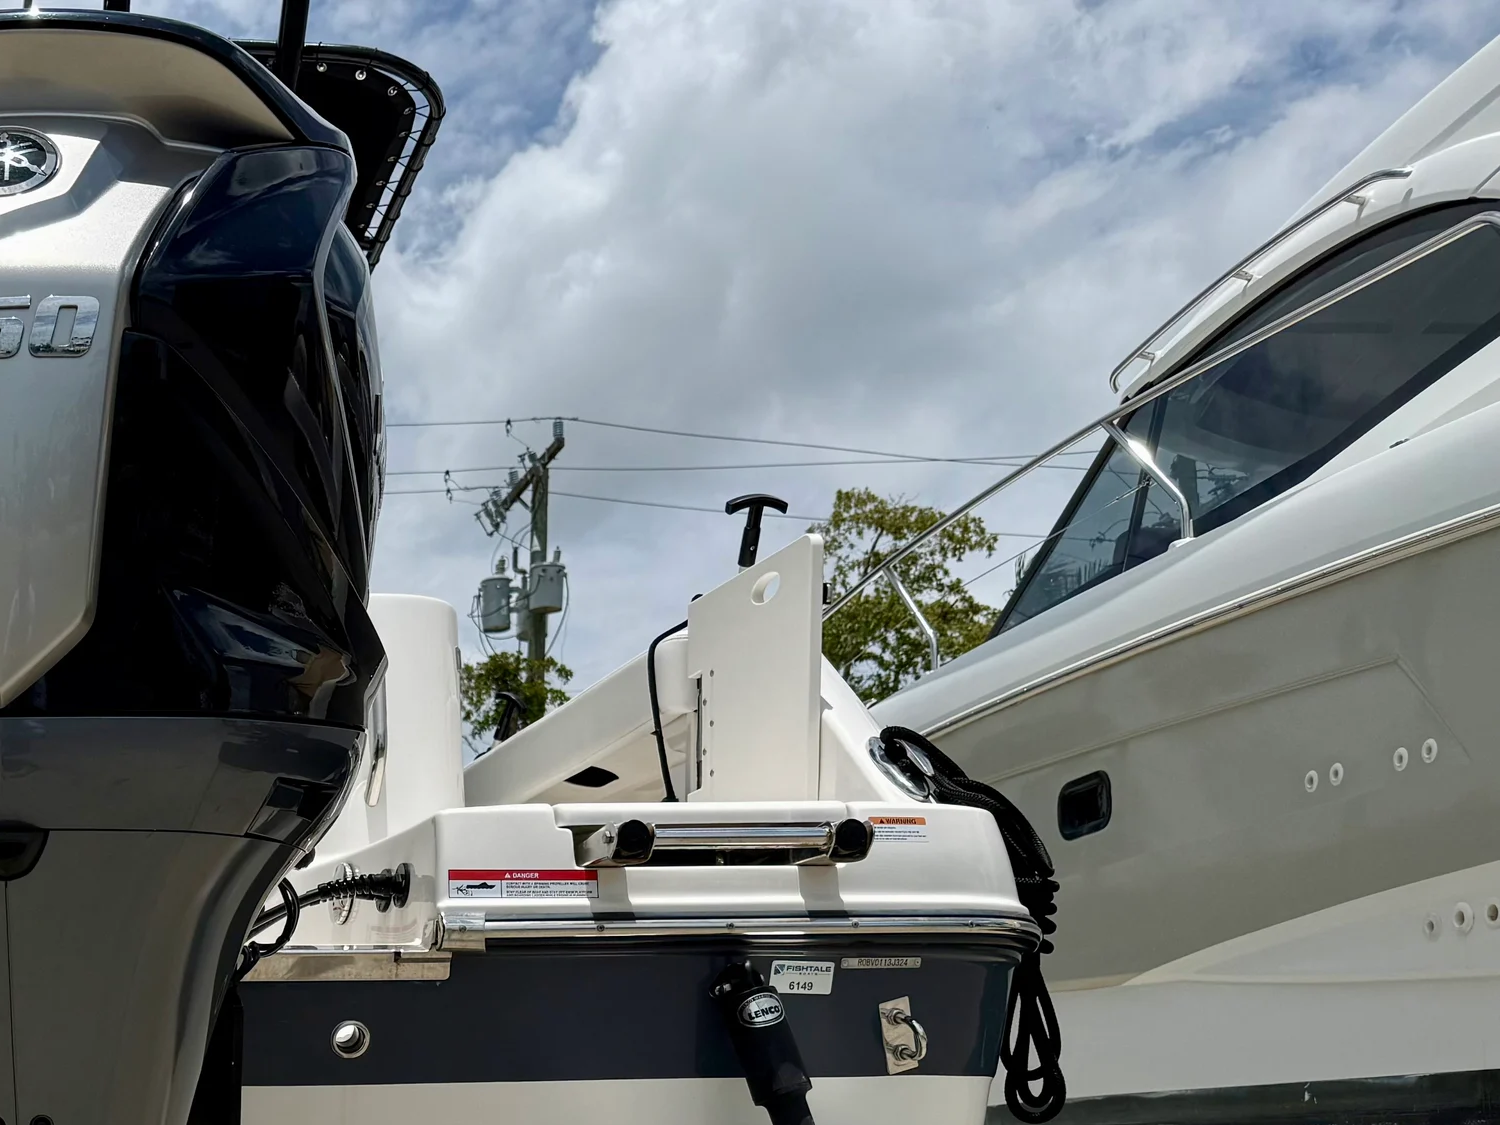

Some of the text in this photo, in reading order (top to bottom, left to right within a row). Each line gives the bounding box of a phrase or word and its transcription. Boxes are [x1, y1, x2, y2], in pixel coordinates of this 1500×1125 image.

[786, 964, 832, 973] FISHTALE
[788, 981, 813, 991] 6149
[747, 1005, 780, 1021] LENCO
